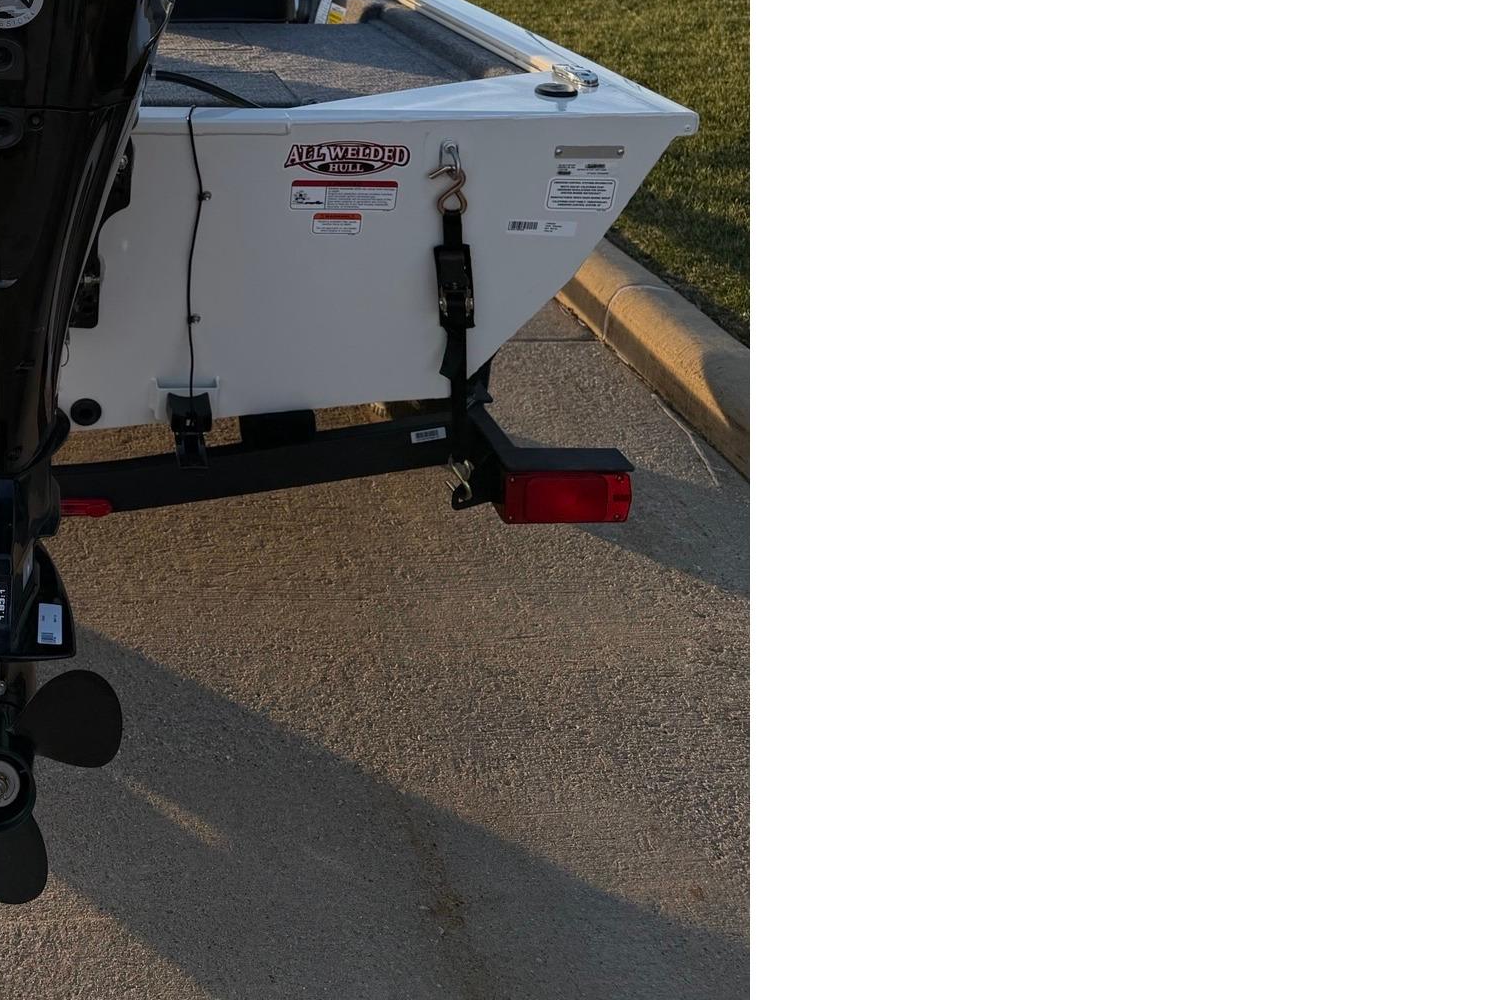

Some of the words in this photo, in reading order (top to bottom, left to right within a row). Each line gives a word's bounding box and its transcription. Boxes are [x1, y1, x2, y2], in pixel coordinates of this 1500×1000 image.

[286, 144, 324, 166] ALL
[327, 145, 409, 166] WELDED
[329, 163, 364, 172] HULL
